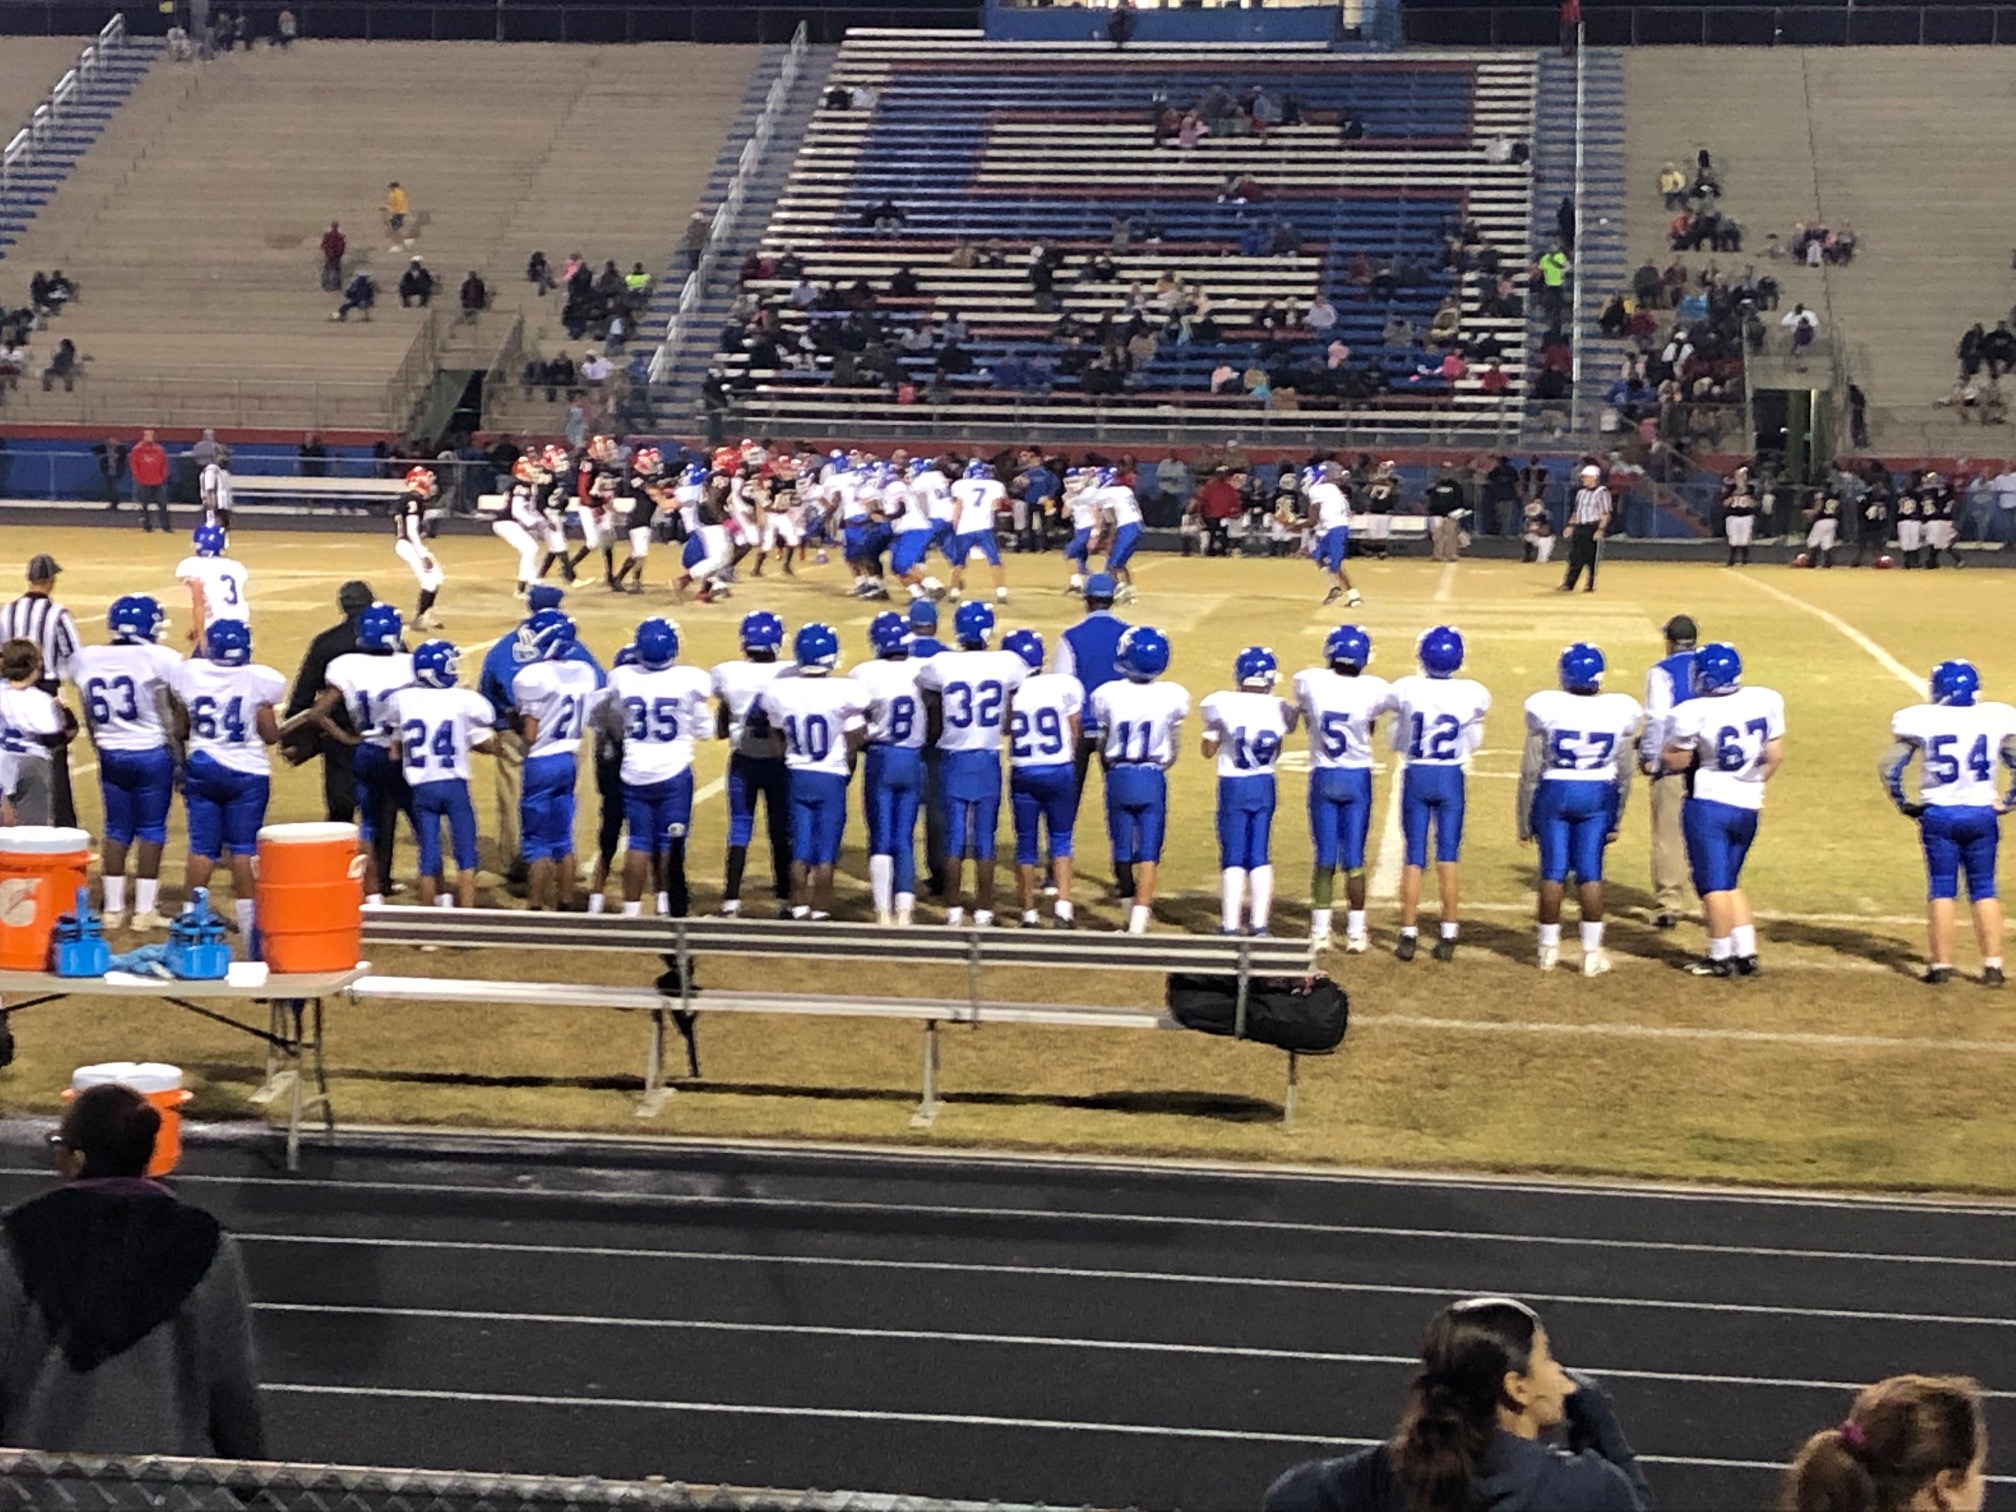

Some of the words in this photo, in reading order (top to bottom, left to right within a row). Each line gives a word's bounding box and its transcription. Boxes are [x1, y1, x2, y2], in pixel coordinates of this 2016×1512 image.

[971, 487, 987, 507] 7
[220, 574, 238, 604] 3
[88, 675, 138, 724] 63
[190, 696, 245, 742] 64
[623, 695, 679, 742] 35
[891, 695, 915, 740] 8
[944, 680, 1002, 728] 32
[402, 719, 456, 768] 24
[785, 714, 828, 762] 10
[1012, 707, 1063, 757] 29
[1116, 720, 1153, 760] 11
[1321, 710, 1350, 757] 5
[1410, 712, 1460, 760] 12
[1552, 729, 1615, 770] 57
[1716, 717, 1769, 772] 67
[1932, 734, 1990, 783] 54
